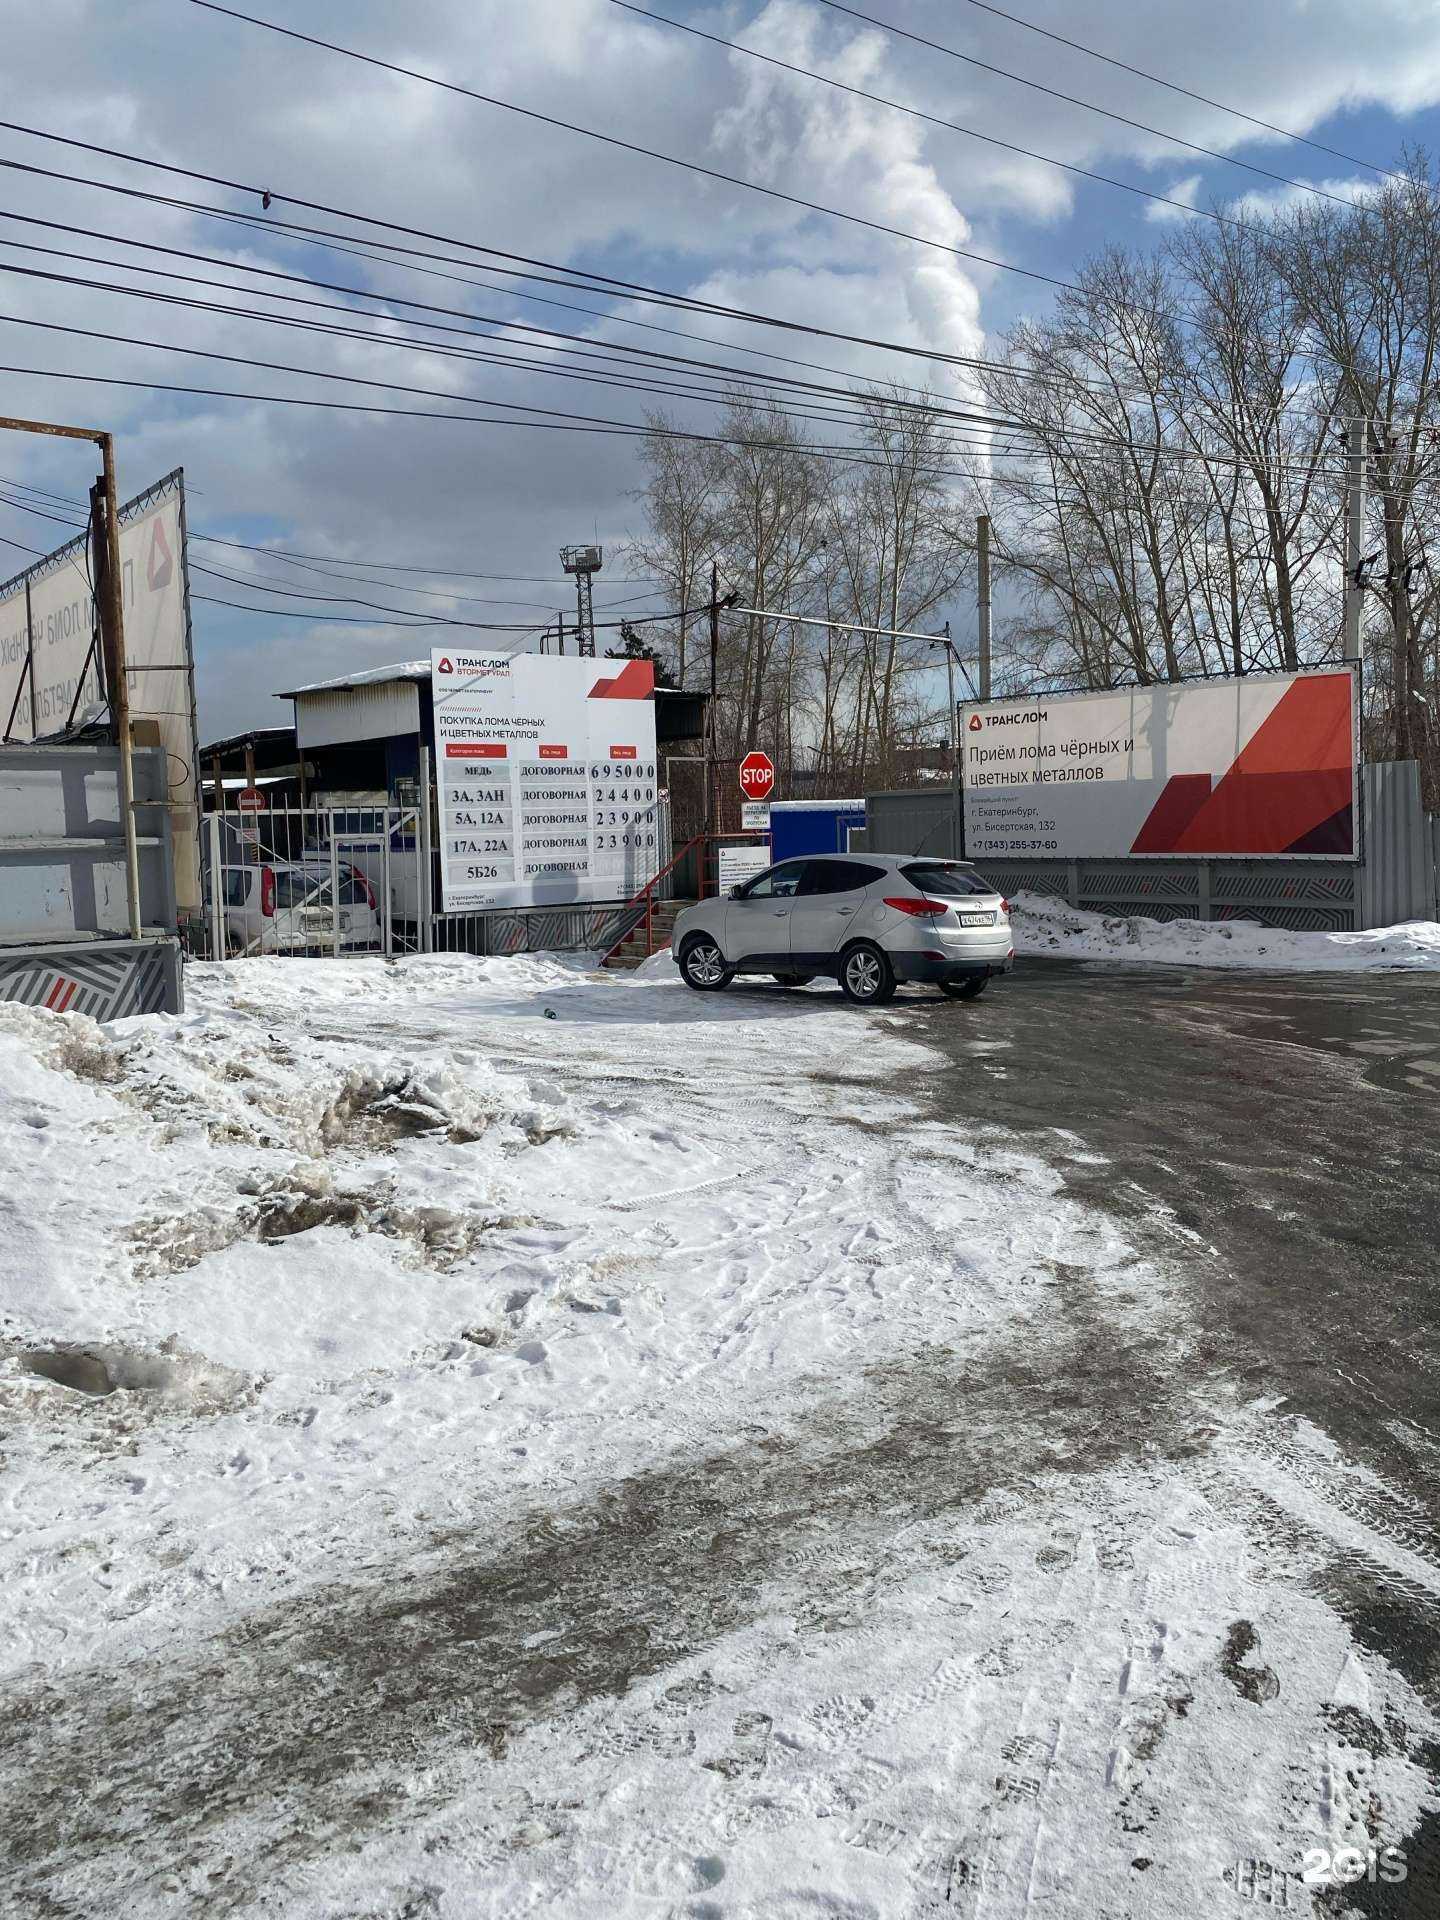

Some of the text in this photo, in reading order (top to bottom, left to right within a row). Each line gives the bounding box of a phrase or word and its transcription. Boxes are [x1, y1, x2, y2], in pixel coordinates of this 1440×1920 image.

[456, 658, 510, 669] ТРАНСЛОМ
[440, 716, 483, 726] ПОКУПКА
[484, 717, 510, 726] ЛОМА
[985, 712, 1048, 726] ТРАНСЛОМ
[440, 729, 538, 739] И ЦВЕТНЫХ МЕТАЛЛОВ
[970, 739, 1134, 765] Приём лома чёрных и
[465, 767, 492, 776] МЕДЬ
[521, 766, 585, 777] ДОГОВОРНАЯ
[742, 768, 772, 784] STOP
[971, 766, 1104, 788] цветных металлов
[452, 790, 474, 803] 3А,
[477, 790, 504, 802] 3АН
[522, 790, 587, 801] ДОГОВОРНАЯ
[455, 813, 477, 826] 5А,
[481, 812, 504, 825] 12А
[523, 814, 587, 825] ДОГОВОРНАЯ
[972, 821, 1056, 833] ул. Бисертская, 132
[454, 840, 481, 854] 17А,
[484, 839, 508, 852] 22А
[523, 838, 587, 850] ДОГОВОРНАЯ
[984, 840, 1008, 851] (343)
[1010, 840, 1057, 849] 255-37-60
[467, 862, 588, 879] 5Б26 ДОГОВОРНАЯ
